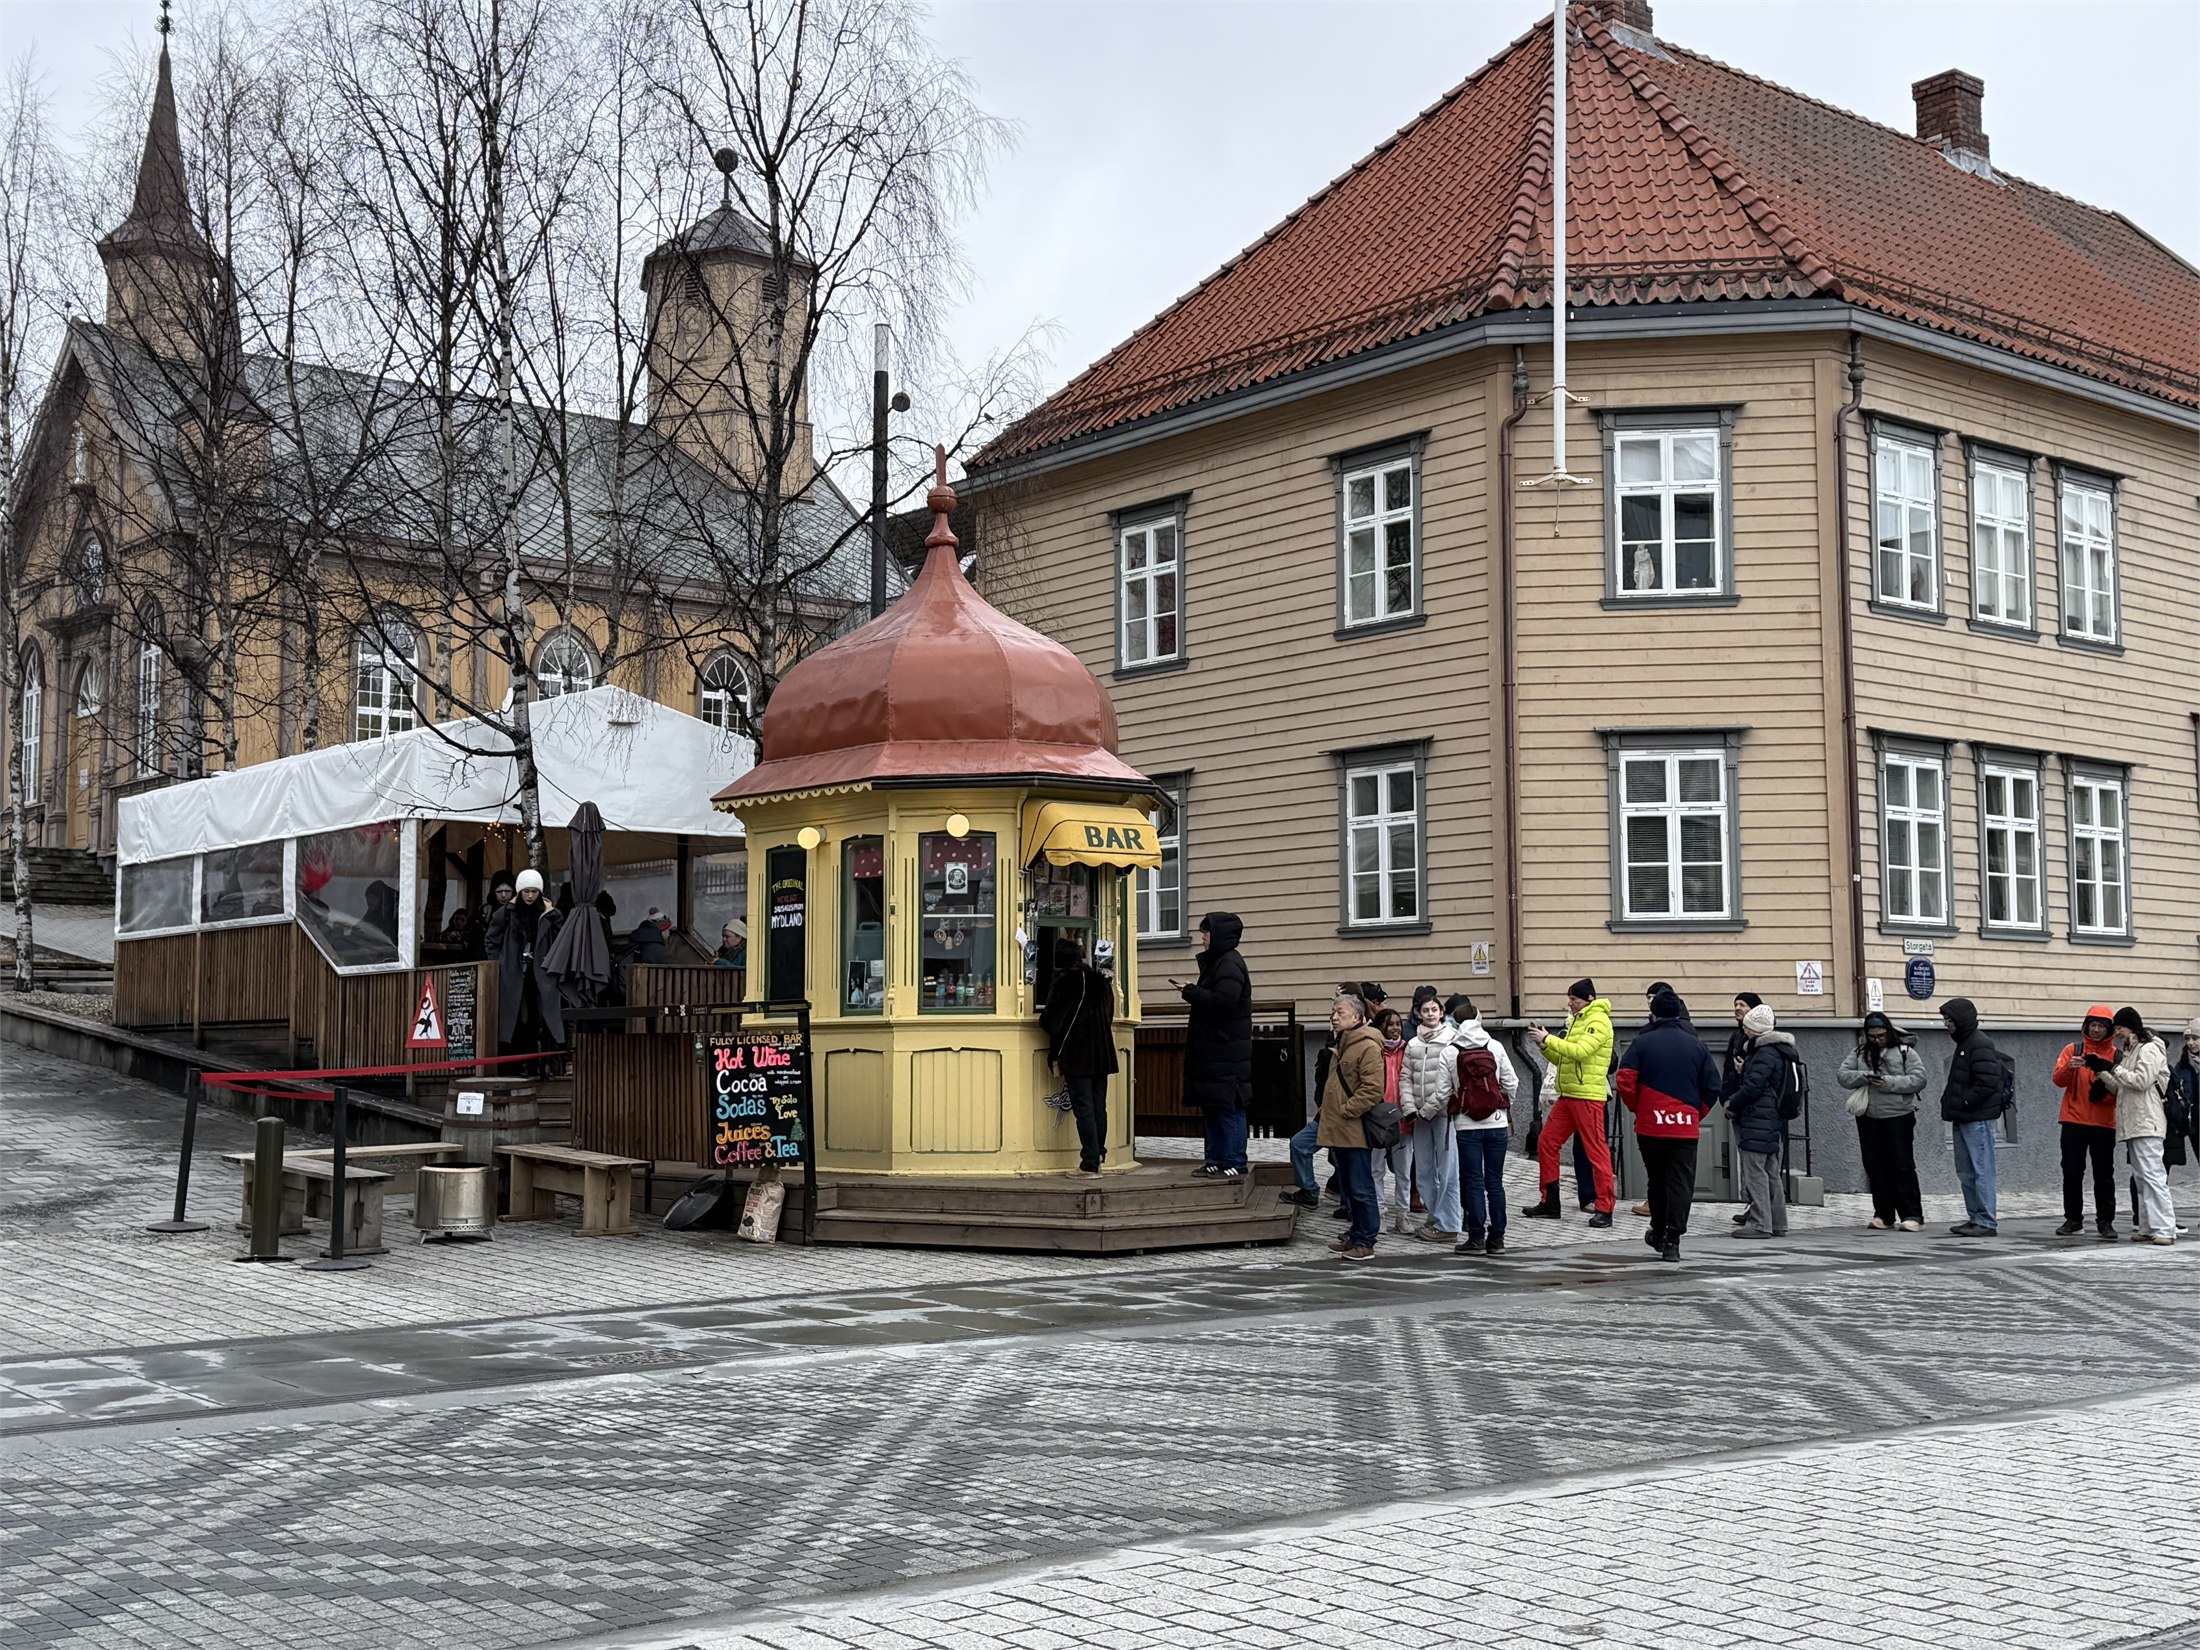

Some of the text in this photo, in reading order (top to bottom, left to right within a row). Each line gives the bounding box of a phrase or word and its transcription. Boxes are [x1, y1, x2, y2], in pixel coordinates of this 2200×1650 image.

[1084, 825, 1145, 850] BAR
[771, 912, 803, 929] MYDLAND
[1906, 941, 1932, 952] Storgata
[710, 1033, 803, 1046] FULLY LICENSED BAR
[714, 1046, 791, 1071] Hot Wine
[716, 1069, 768, 1094] Cocoa
[716, 1095, 767, 1119] Sodas
[769, 1094, 798, 1105] Try Solo
[778, 1110, 798, 1120] Love
[1653, 1110, 1692, 1125] Yeti
[716, 1122, 772, 1144] Juices
[715, 1135, 800, 1165] Coffee & Tea
